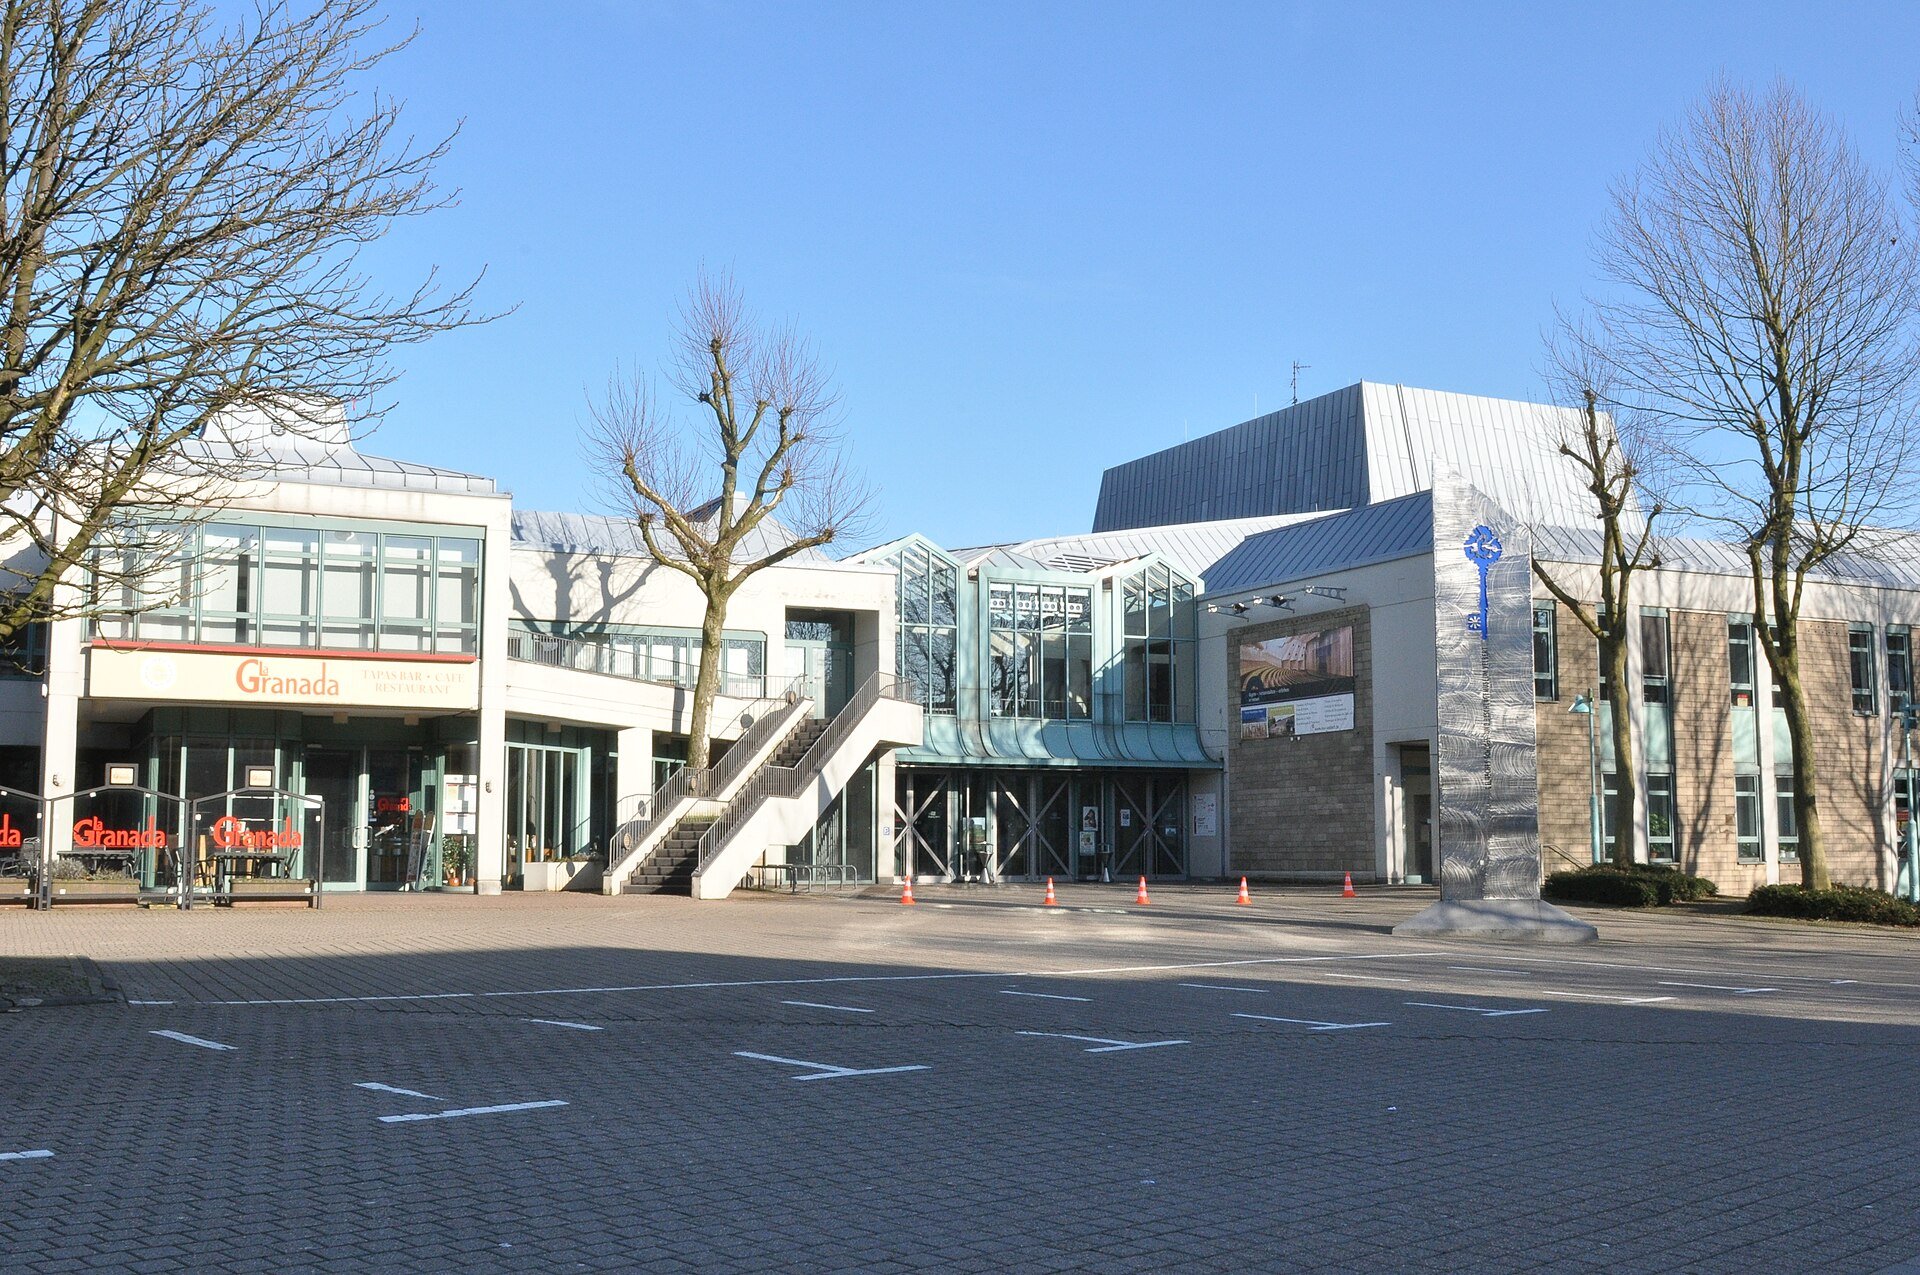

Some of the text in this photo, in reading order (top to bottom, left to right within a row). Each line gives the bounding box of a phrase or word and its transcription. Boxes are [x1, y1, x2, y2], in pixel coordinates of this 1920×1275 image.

[236, 659, 339, 696] Granada
[362, 669, 397, 682] TAPAS
[399, 671, 422, 682] BAR
[375, 682, 450, 695] RESTAURANT
[73, 815, 167, 847] Granada
[213, 816, 302, 848] Granada
